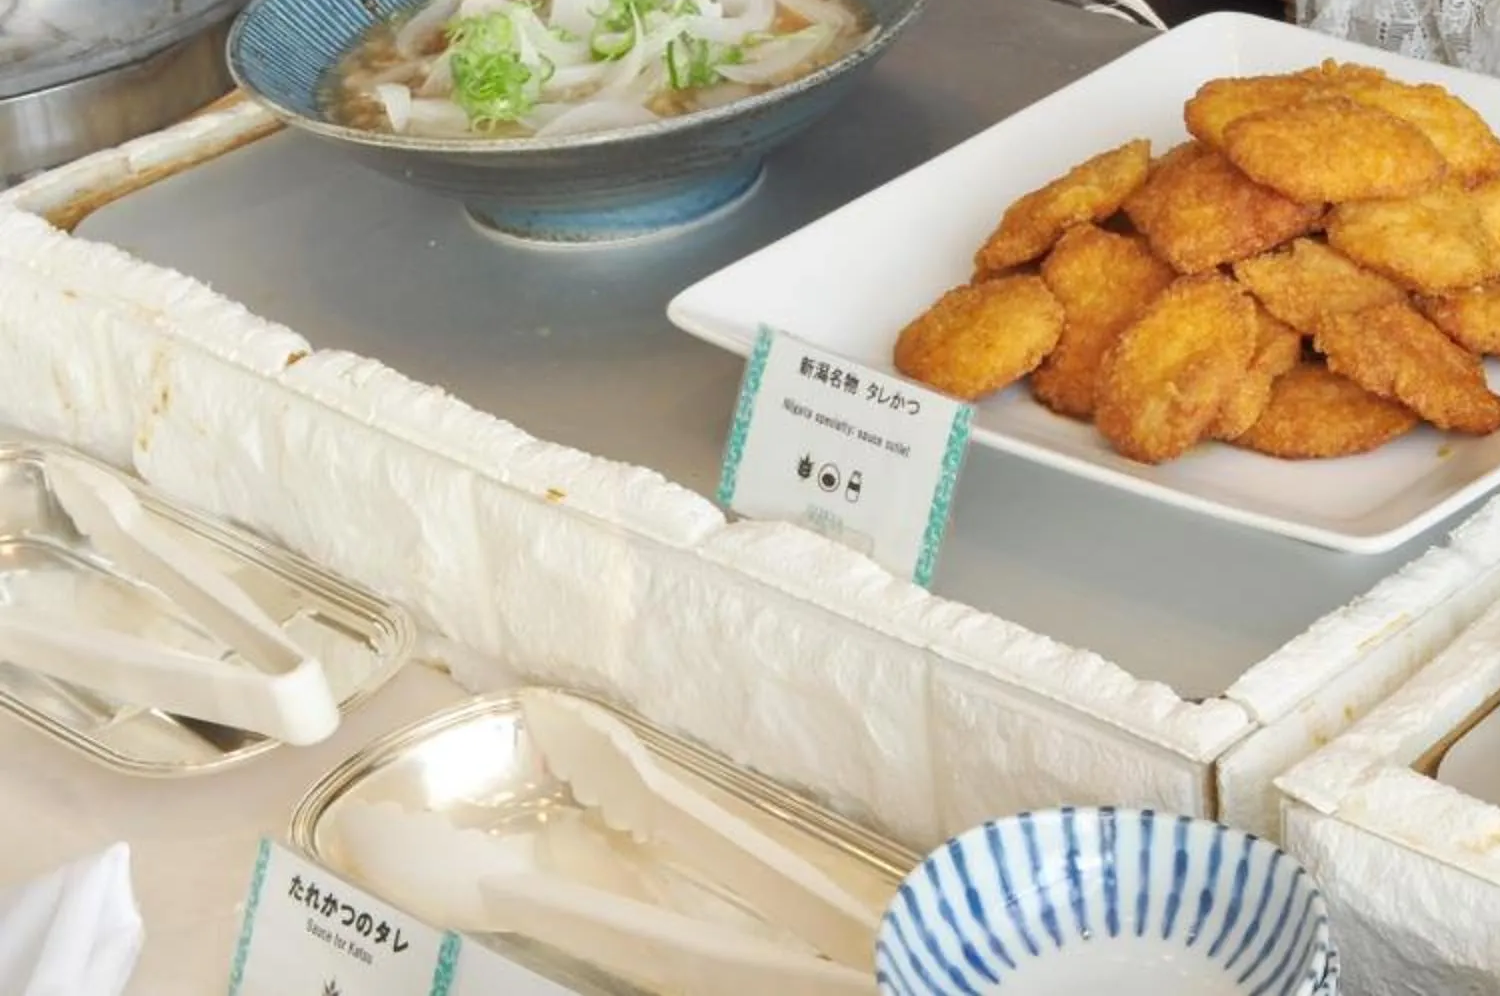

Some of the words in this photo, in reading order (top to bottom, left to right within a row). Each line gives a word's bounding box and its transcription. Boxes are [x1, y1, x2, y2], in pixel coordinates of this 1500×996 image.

[799, 356, 860, 395] 新潟名物
[865, 382, 921, 415] タレかつ
[288, 875, 409, 952] たれかつのタレ
[306, 917, 333, 943] Sauce
